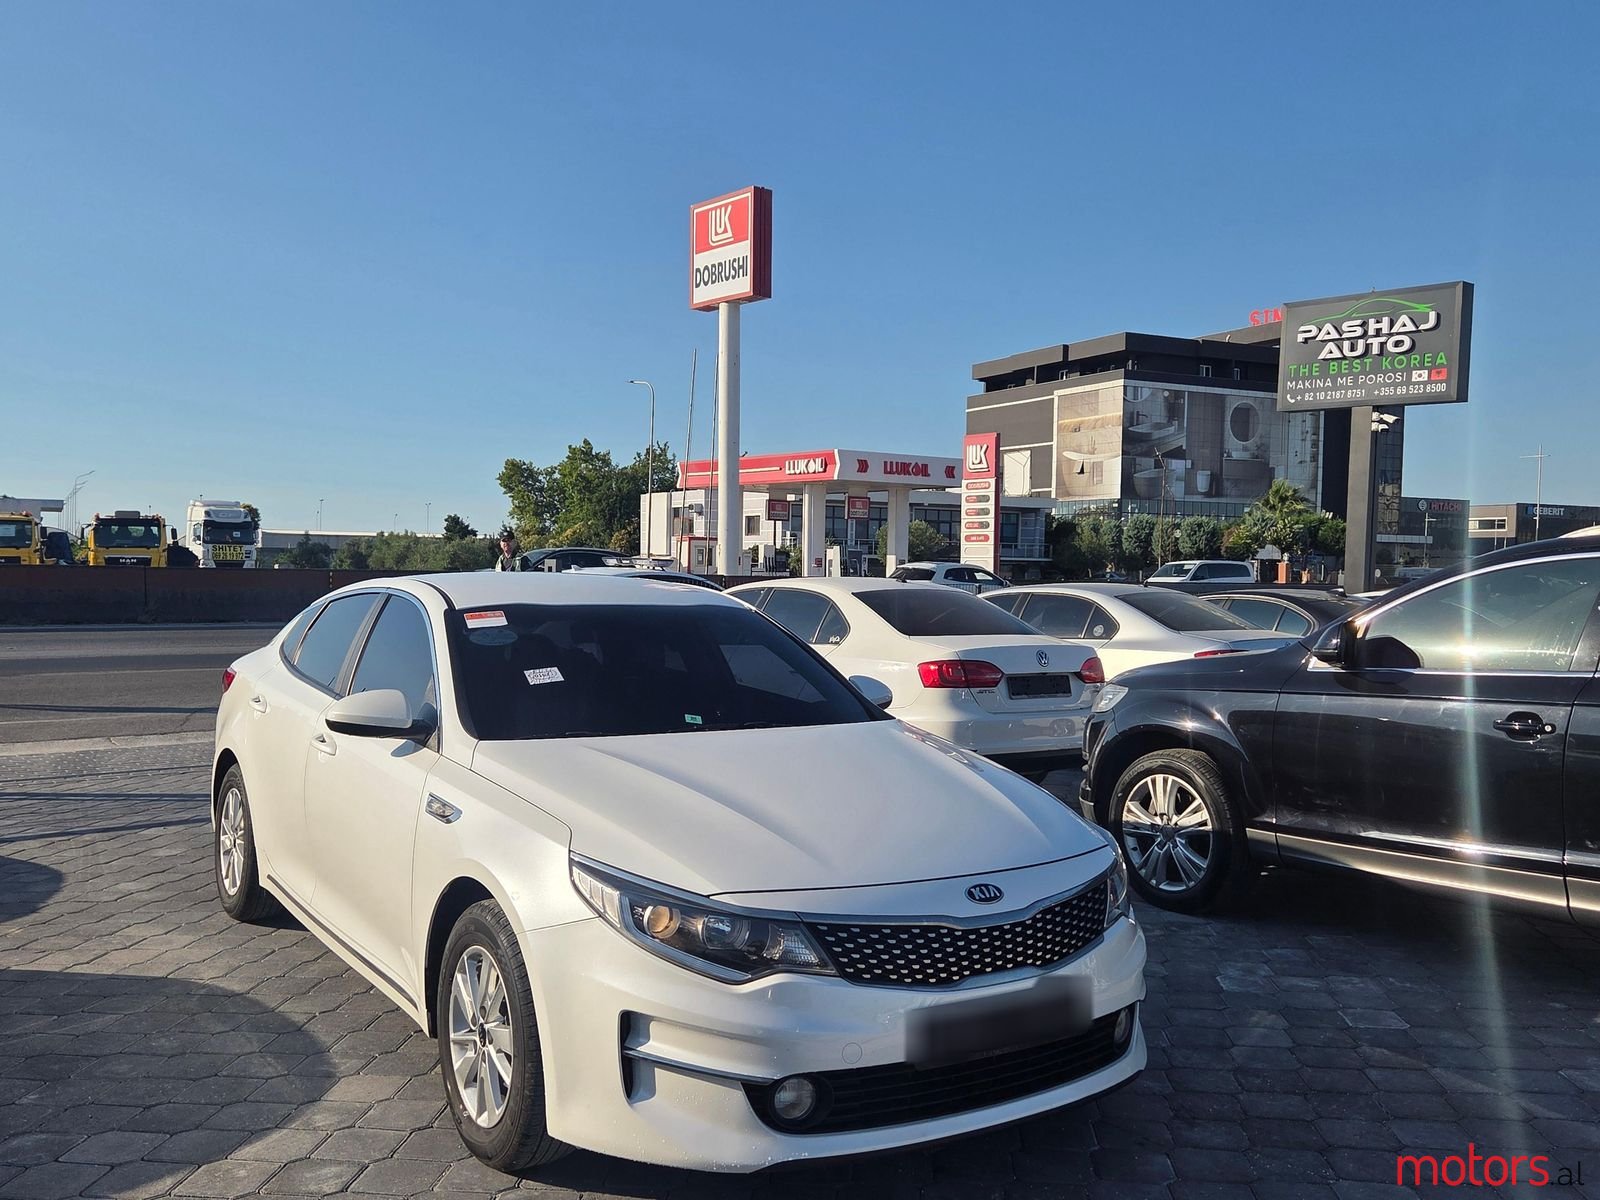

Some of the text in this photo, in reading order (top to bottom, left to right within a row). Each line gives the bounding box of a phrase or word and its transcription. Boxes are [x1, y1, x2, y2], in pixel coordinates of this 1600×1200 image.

[695, 255, 748, 288] DOBRUSHI
[1297, 311, 1439, 343] PASHAJ
[1318, 335, 1413, 360] AUTO
[1288, 352, 1448, 377] THE BEST KOREA
[1287, 372, 1407, 390] MAKINA ME POROSI
[1304, 392, 1314, 400] 82
[1316, 391, 1325, 400] 10
[1326, 390, 1345, 399] 2187
[1347, 389, 1365, 398] 8751
[1373, 386, 1395, 396] +355
[1396, 385, 1407, 395] 69
[1408, 384, 1424, 394] 523
[1425, 382, 1447, 393] 8500
[1430, 501, 1462, 511] HITACHI
[1533, 506, 1564, 516] GEBERIT
[212, 544, 244, 552] SHITET
[970, 885, 1000, 899] KIA
